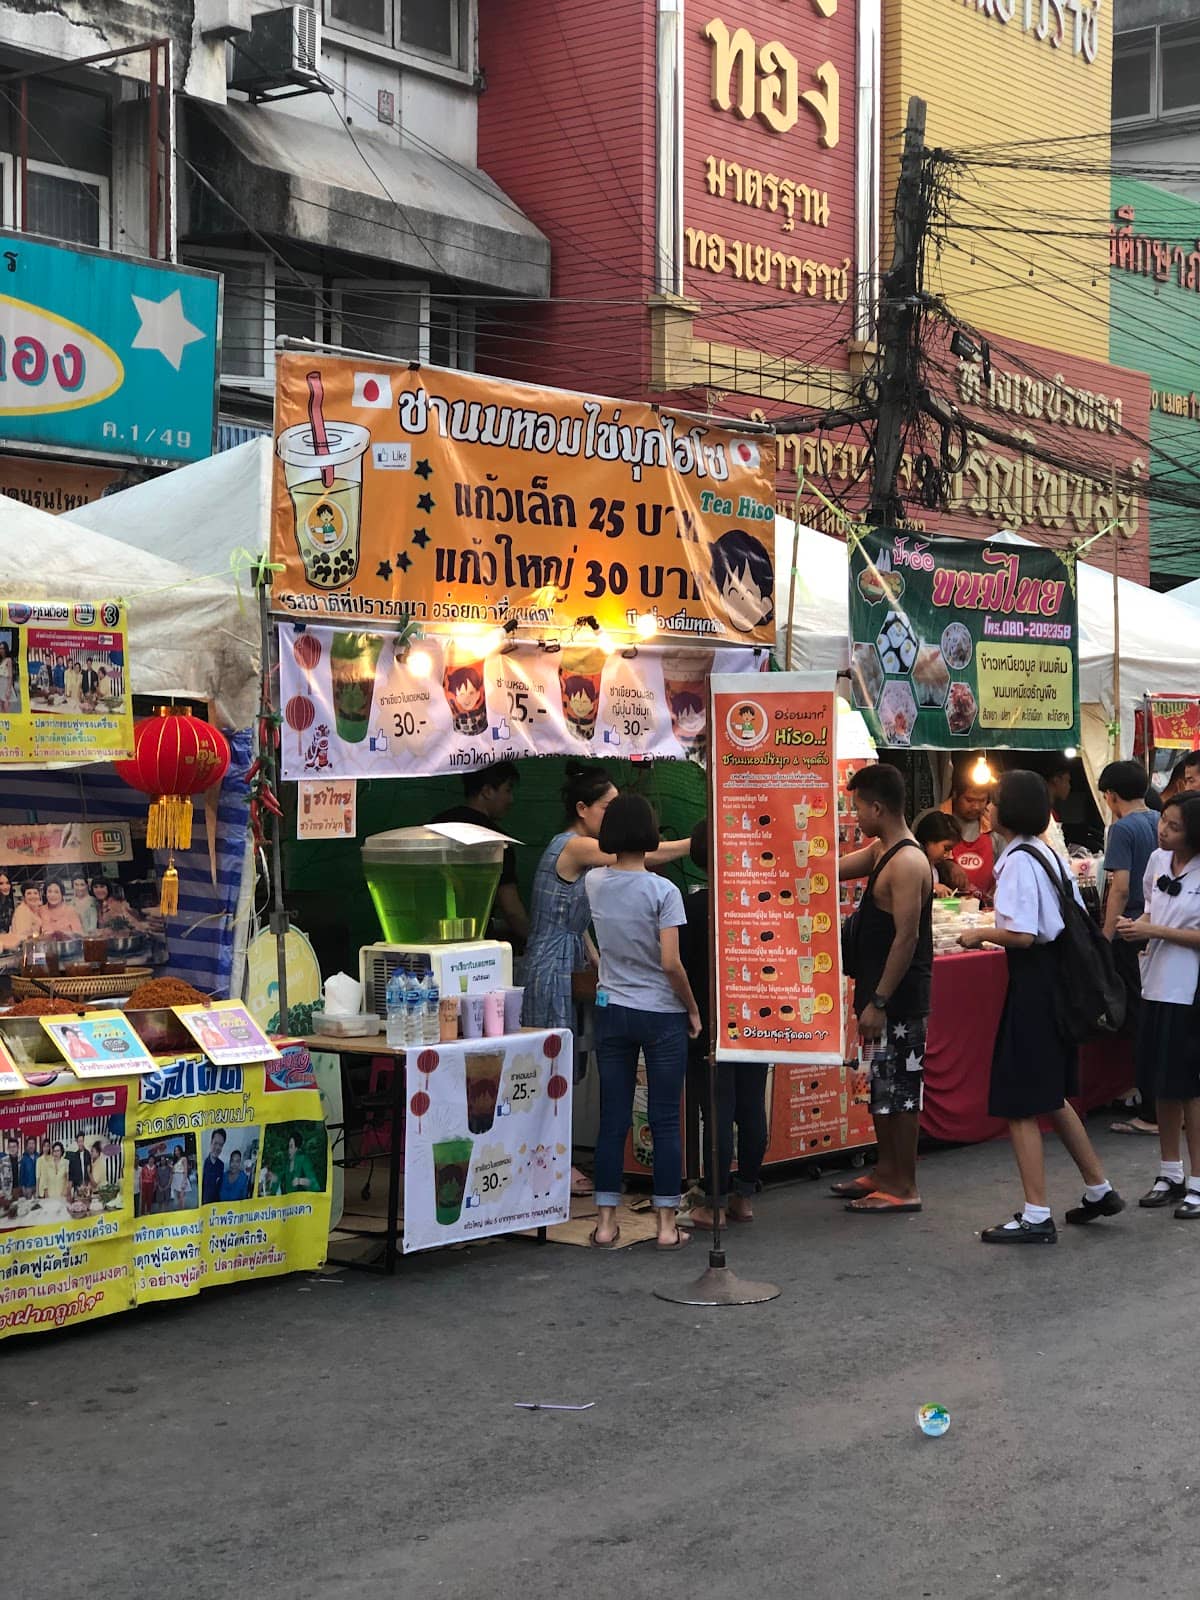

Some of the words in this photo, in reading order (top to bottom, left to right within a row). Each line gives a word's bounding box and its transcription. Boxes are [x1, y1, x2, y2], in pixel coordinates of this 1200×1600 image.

[705, 17, 840, 148] ทอง
[706, 154, 830, 231] มาตรฐาน
[685, 227, 850, 304] ทองเยาวราช
[0, 335, 86, 393] อง
[392, 449, 407, 462] Like
[398, 387, 730, 482] ชานมหอมไข่มุกไฮโซ
[454, 473, 577, 528] แก้วเล็ก
[589, 497, 626, 538] 25
[700, 491, 733, 514] Tea
[736, 496, 775, 522] Hiso
[435, 533, 577, 604] แก้วใหญ่
[584, 559, 629, 598] 30
[932, 547, 1066, 617] ขนมไทย
[393, 711, 427, 738] 30.-
[623, 719, 650, 736] 30.-
[960, 855, 980, 866] aro
[512, 1083, 536, 1100] 25.-
[482, 1172, 508, 1192] 30.-
